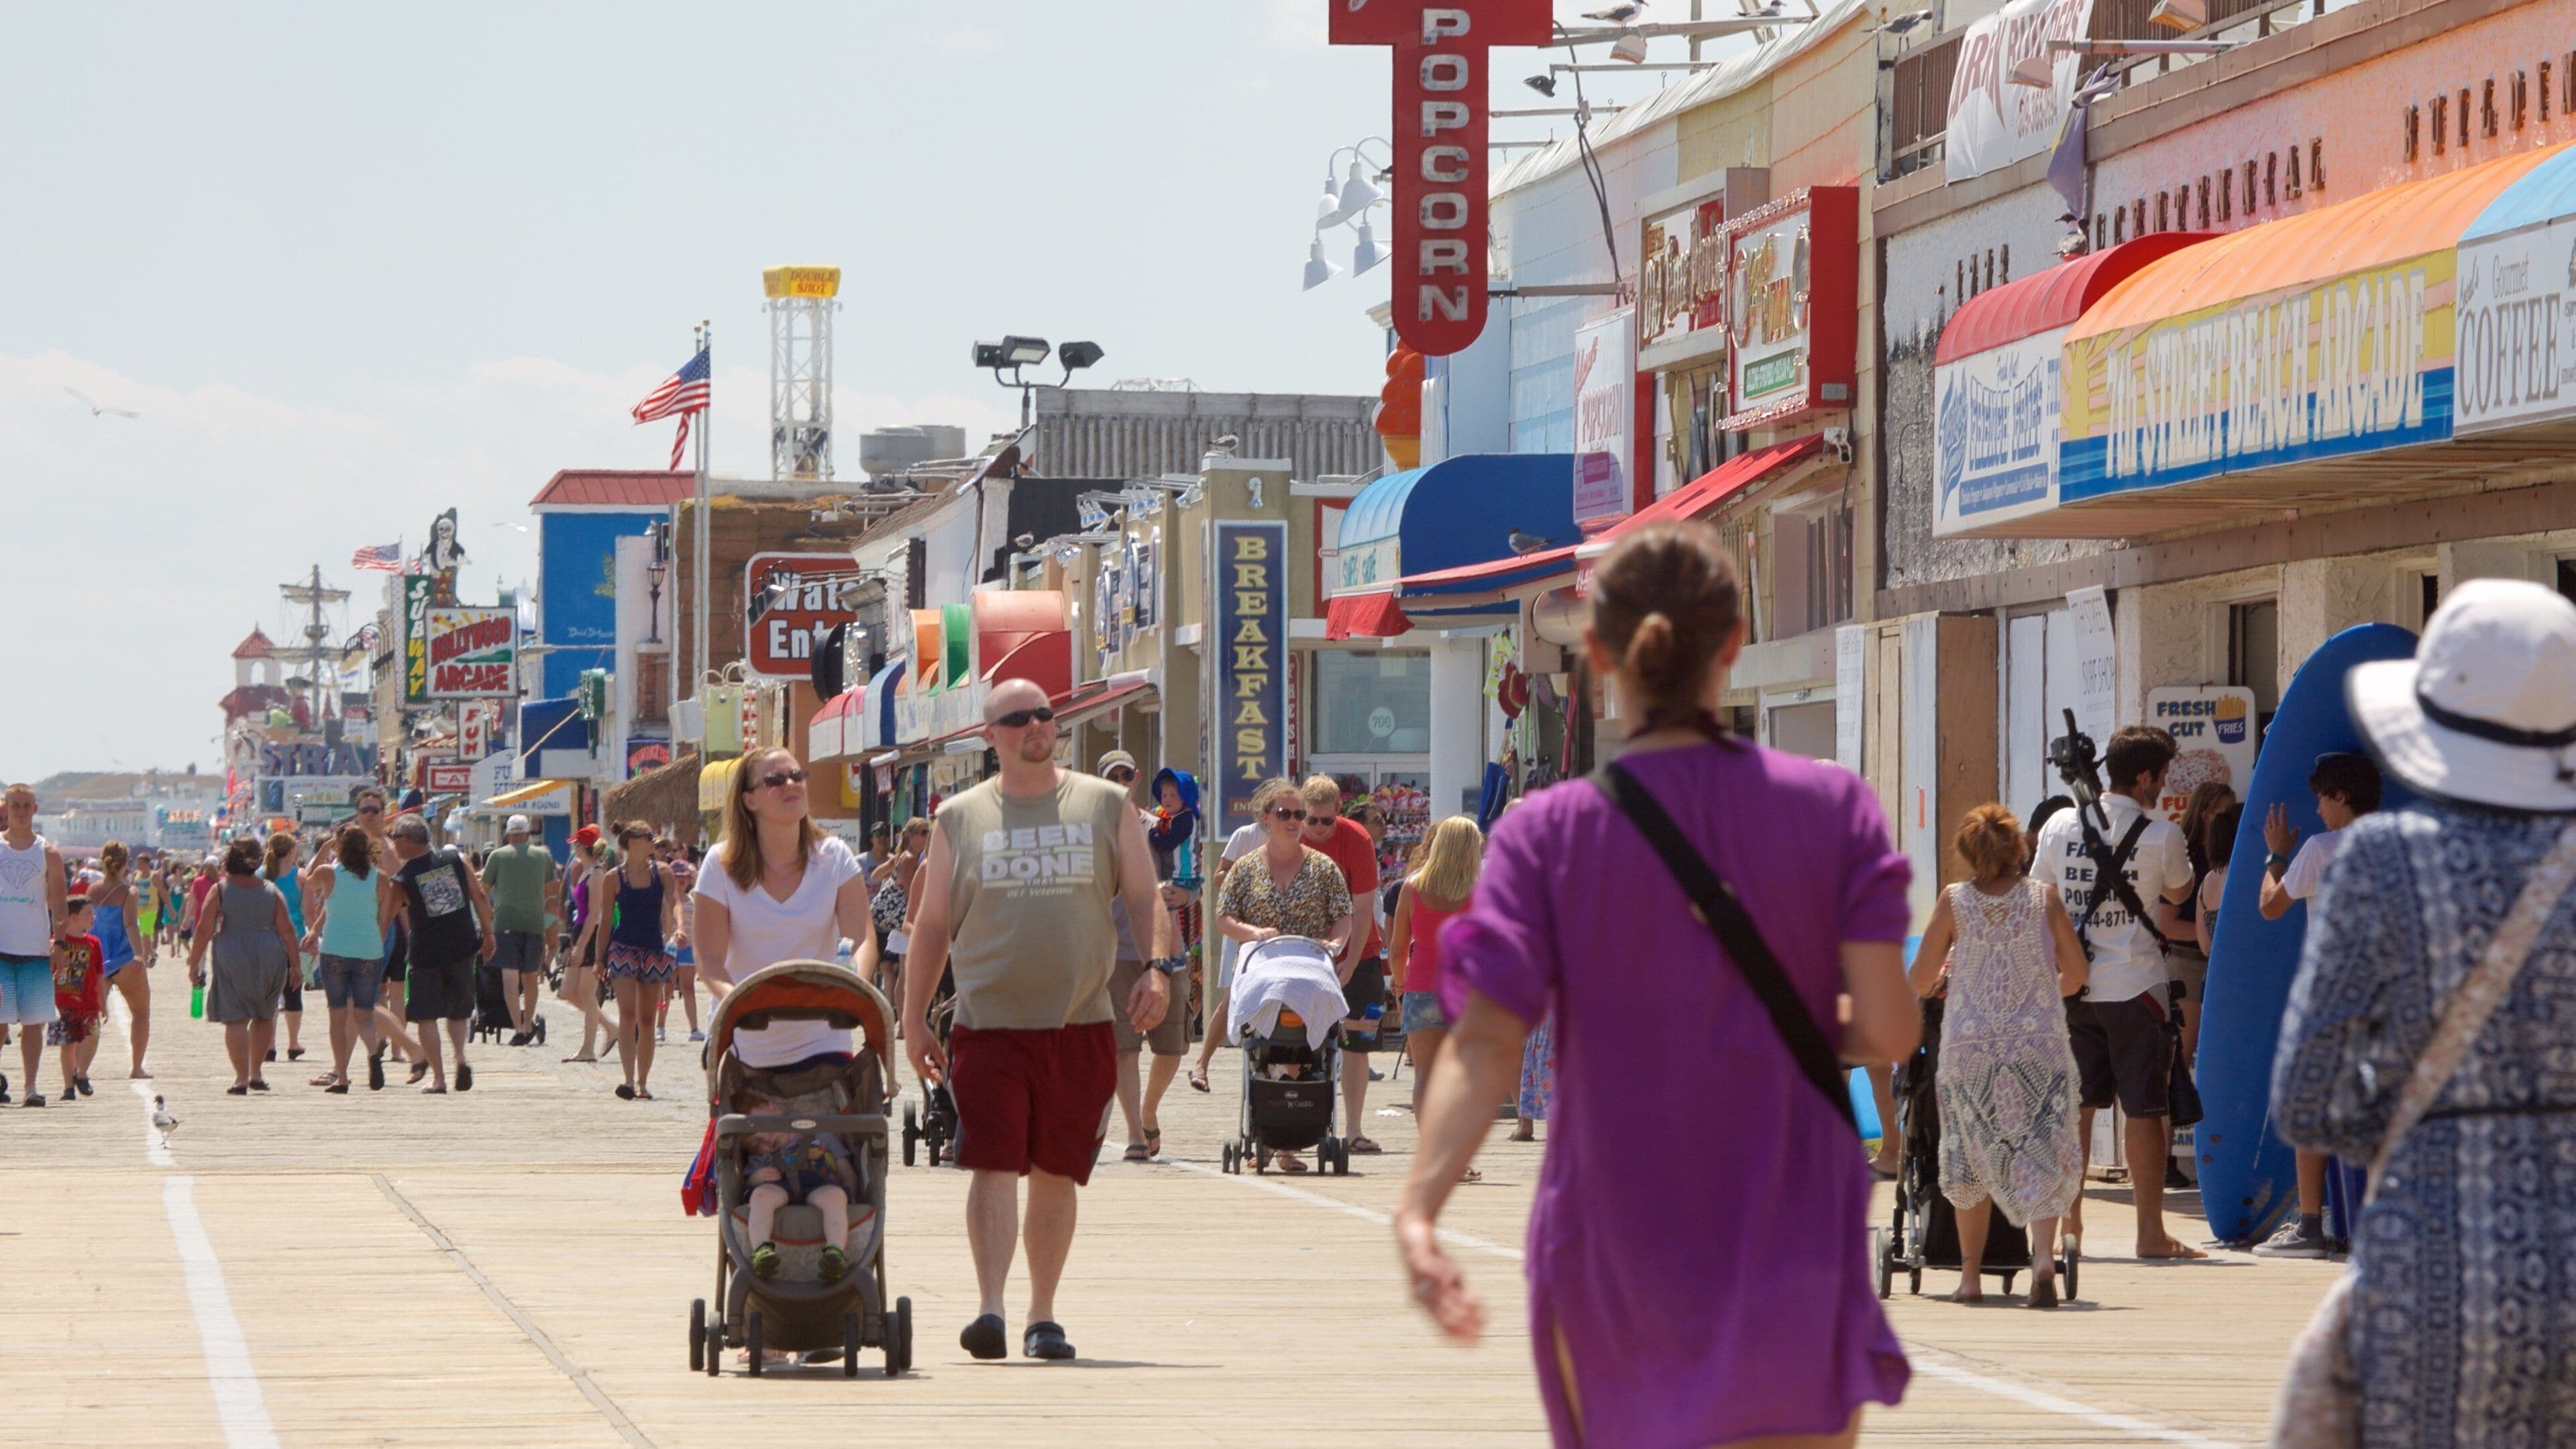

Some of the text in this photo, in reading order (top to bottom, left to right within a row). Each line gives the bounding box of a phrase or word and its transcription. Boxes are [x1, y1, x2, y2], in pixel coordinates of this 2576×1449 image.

[1419, 8, 1470, 322] POPCORN
[791, 270, 836, 281] DOUBLE
[797, 282, 826, 294] SHOT
[2493, 250, 2529, 299] Gourmet
[2460, 292, 2561, 417] COFFEE
[2106, 337, 2139, 480] 7th
[2143, 309, 2229, 476] STREET
[2227, 294, 2310, 457] BEACH
[2314, 268, 2426, 441] ARCADE
[1582, 382, 1623, 444] POPCORN
[407, 579, 431, 696] SUBWAY
[430, 615, 512, 667] HOLLYWOOD
[1233, 535, 1269, 780] BREAKFAST
[2098, 655, 2114, 692] SHOP
[434, 663, 509, 692] ARCADE
[1373, 716, 1391, 729] 700
[2157, 700, 2216, 717] FRESH
[2168, 721, 2244, 737] CUT FRIES
[532, 801, 560, 810] ROUND
[982, 822, 1093, 852] BEEN
[982, 851, 1094, 881] DONE
